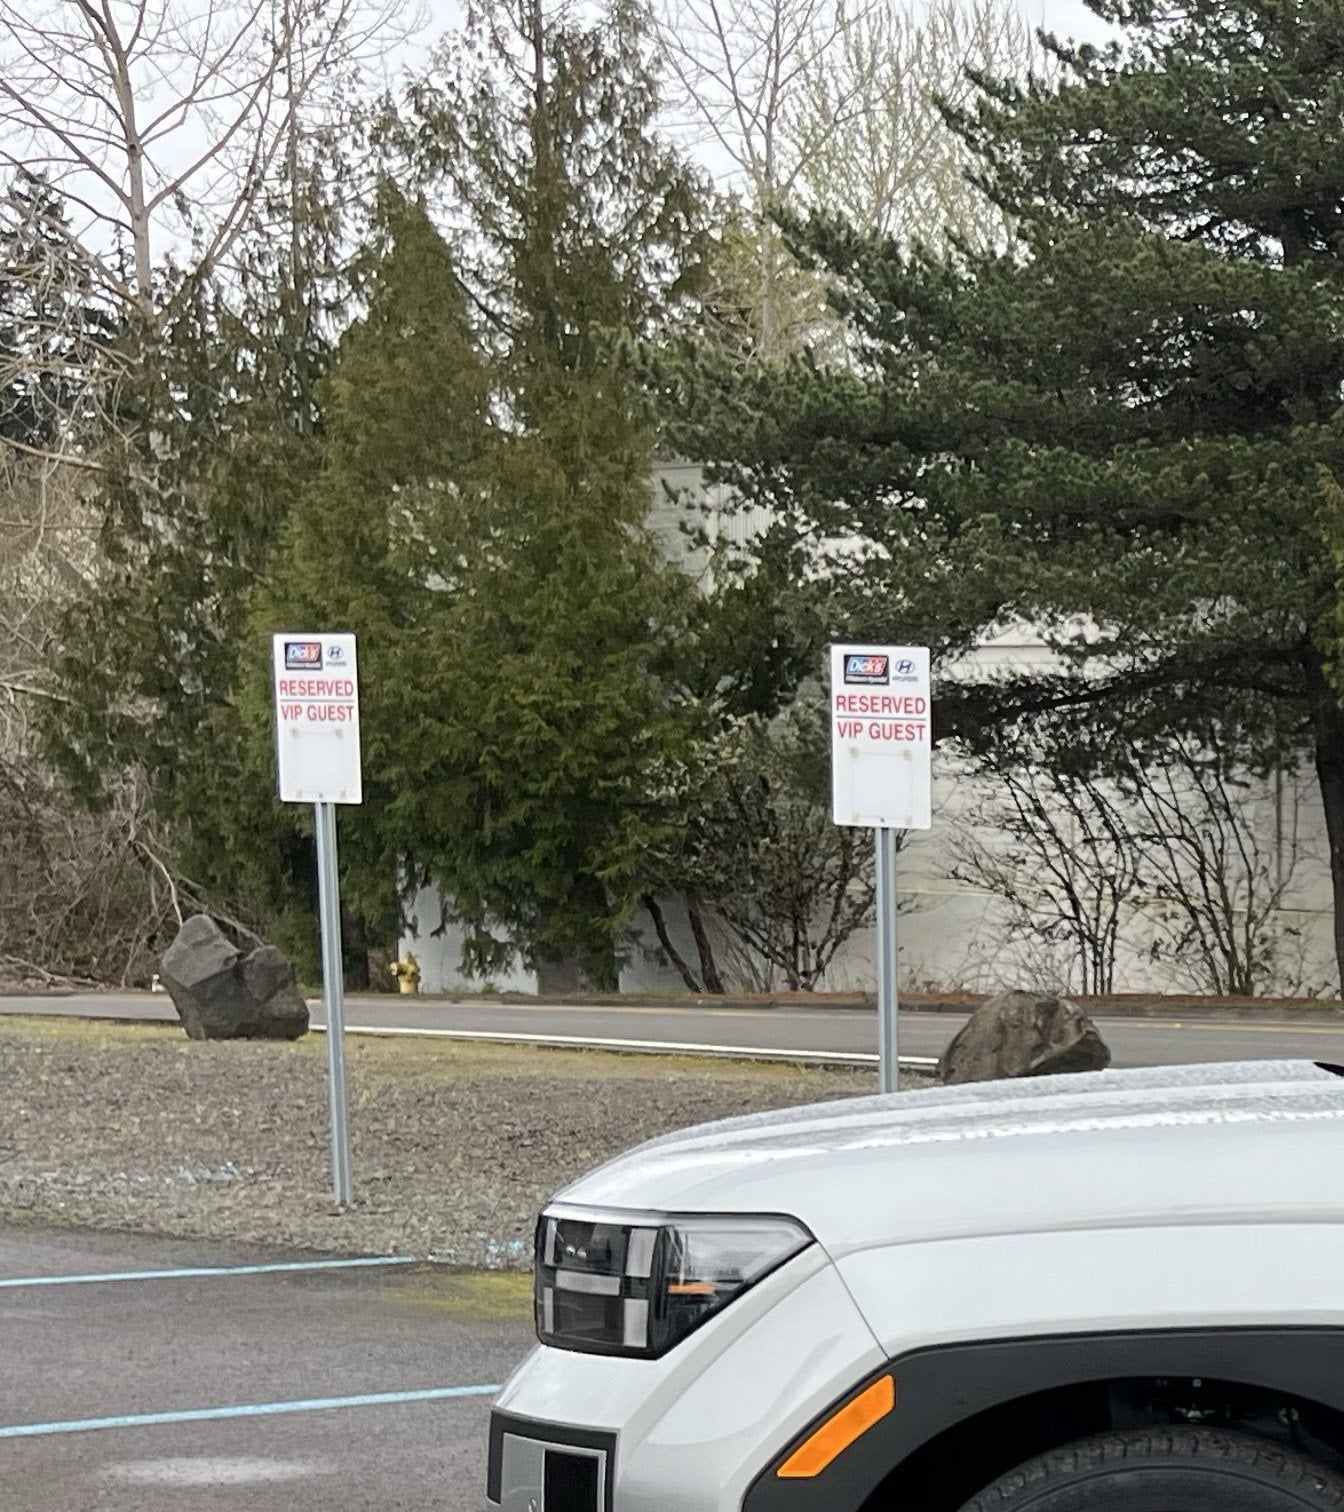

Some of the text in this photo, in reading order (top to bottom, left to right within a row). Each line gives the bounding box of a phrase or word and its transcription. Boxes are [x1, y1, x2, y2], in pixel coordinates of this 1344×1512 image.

[279, 680, 354, 697] RESERVED
[281, 704, 354, 722] VIP GUEST
[836, 695, 926, 714] RESERVED
[837, 722, 926, 741] VIP GUEST
